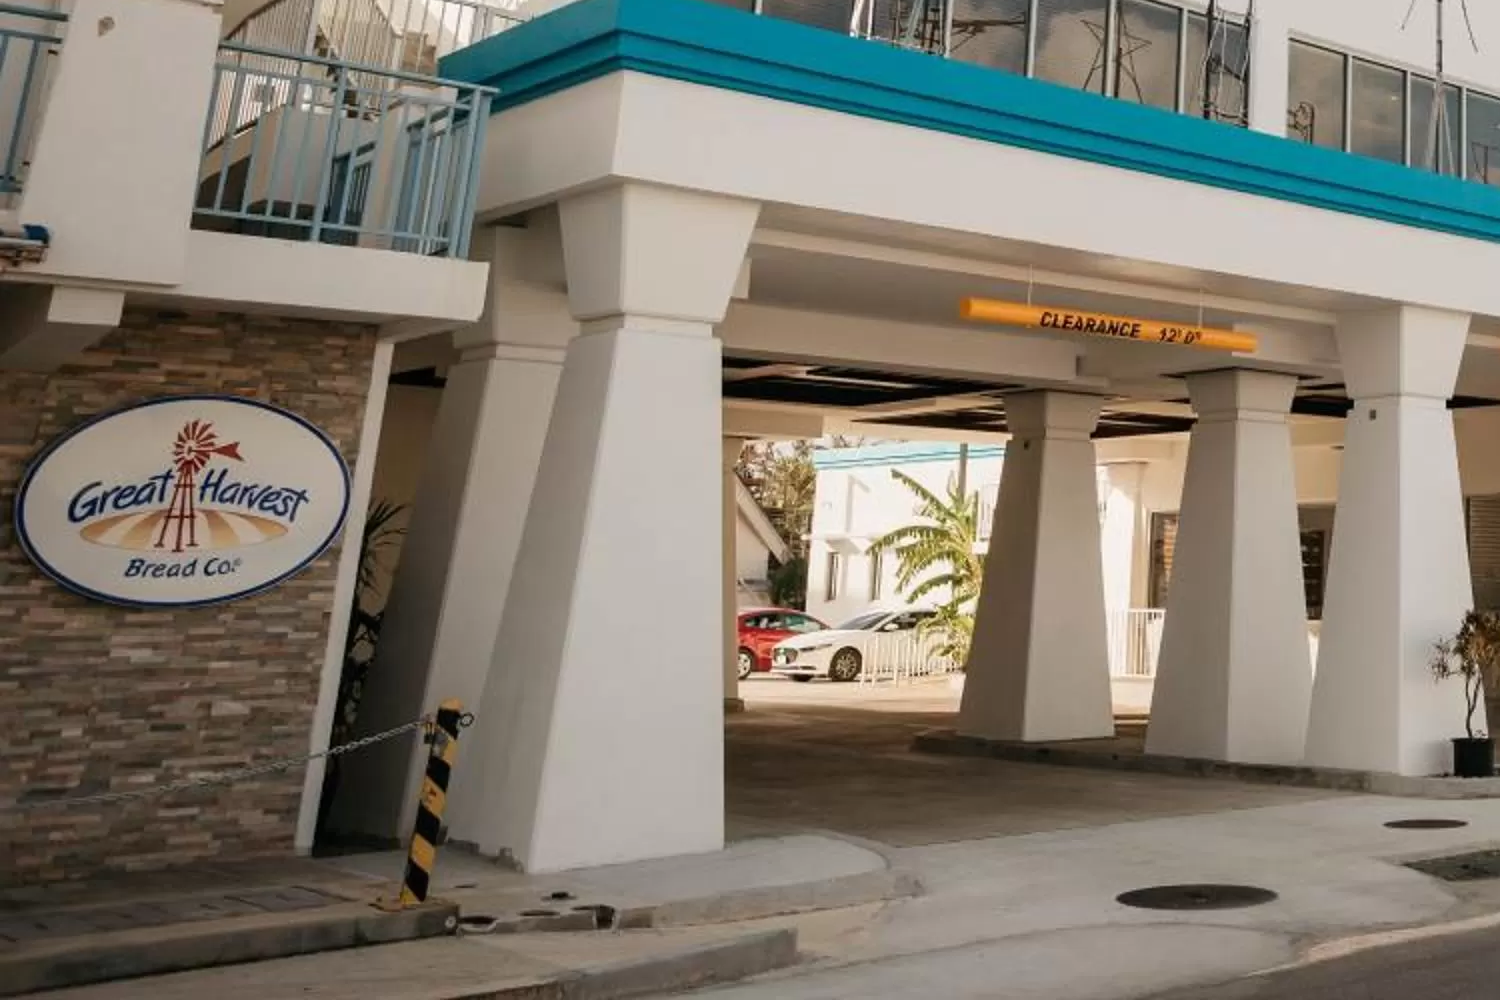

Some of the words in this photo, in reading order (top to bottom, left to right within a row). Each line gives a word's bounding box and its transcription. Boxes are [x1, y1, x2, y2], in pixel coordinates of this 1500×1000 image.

[1040, 311, 1141, 339] CLEARANCE
[67, 470, 175, 524] Great
[200, 467, 309, 522] Harvest
[124, 557, 198, 578] Bread
